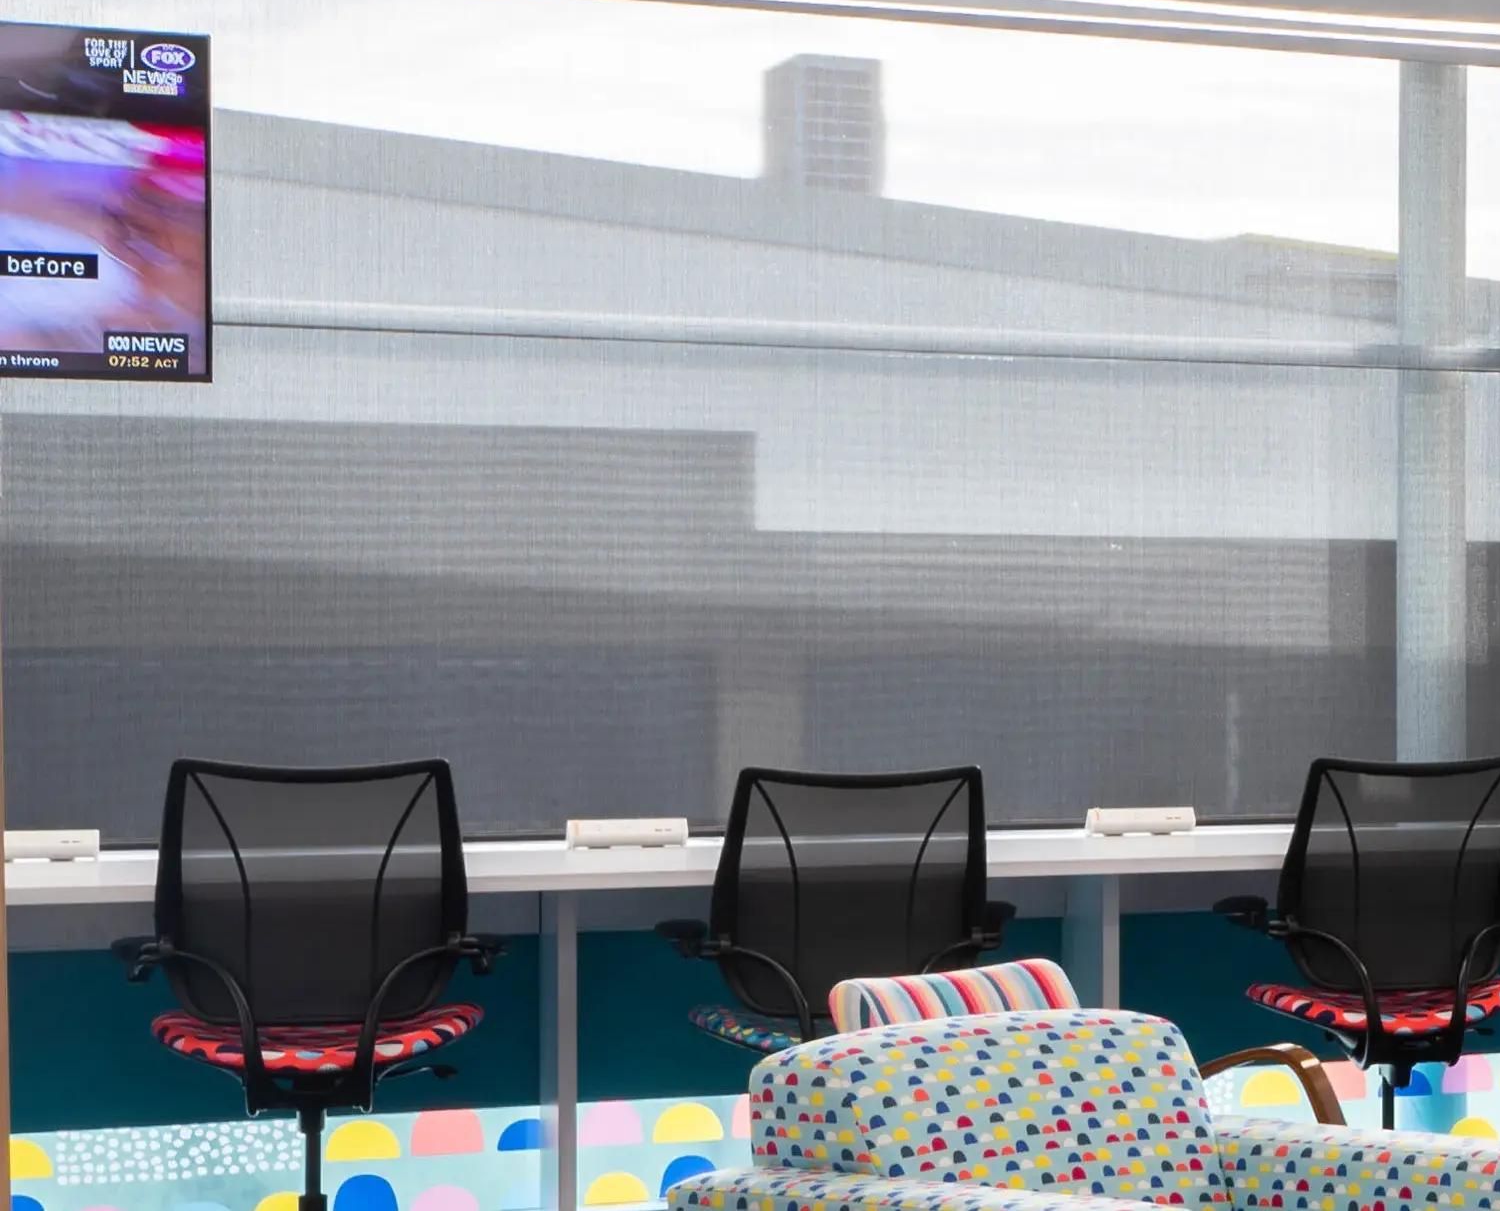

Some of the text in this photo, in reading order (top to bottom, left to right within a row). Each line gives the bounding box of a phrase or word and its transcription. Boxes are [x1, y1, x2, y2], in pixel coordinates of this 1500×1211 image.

[84, 38, 128, 49] FOR THE
[85, 47, 111, 58] LOVE
[151, 50, 185, 65] FOX
[89, 57, 123, 68] SPORT
[8, 255, 85, 276] before
[131, 337, 185, 353] NEWS
[11, 355, 59, 367] throne
[109, 355, 178, 369] 07:52 ACT
